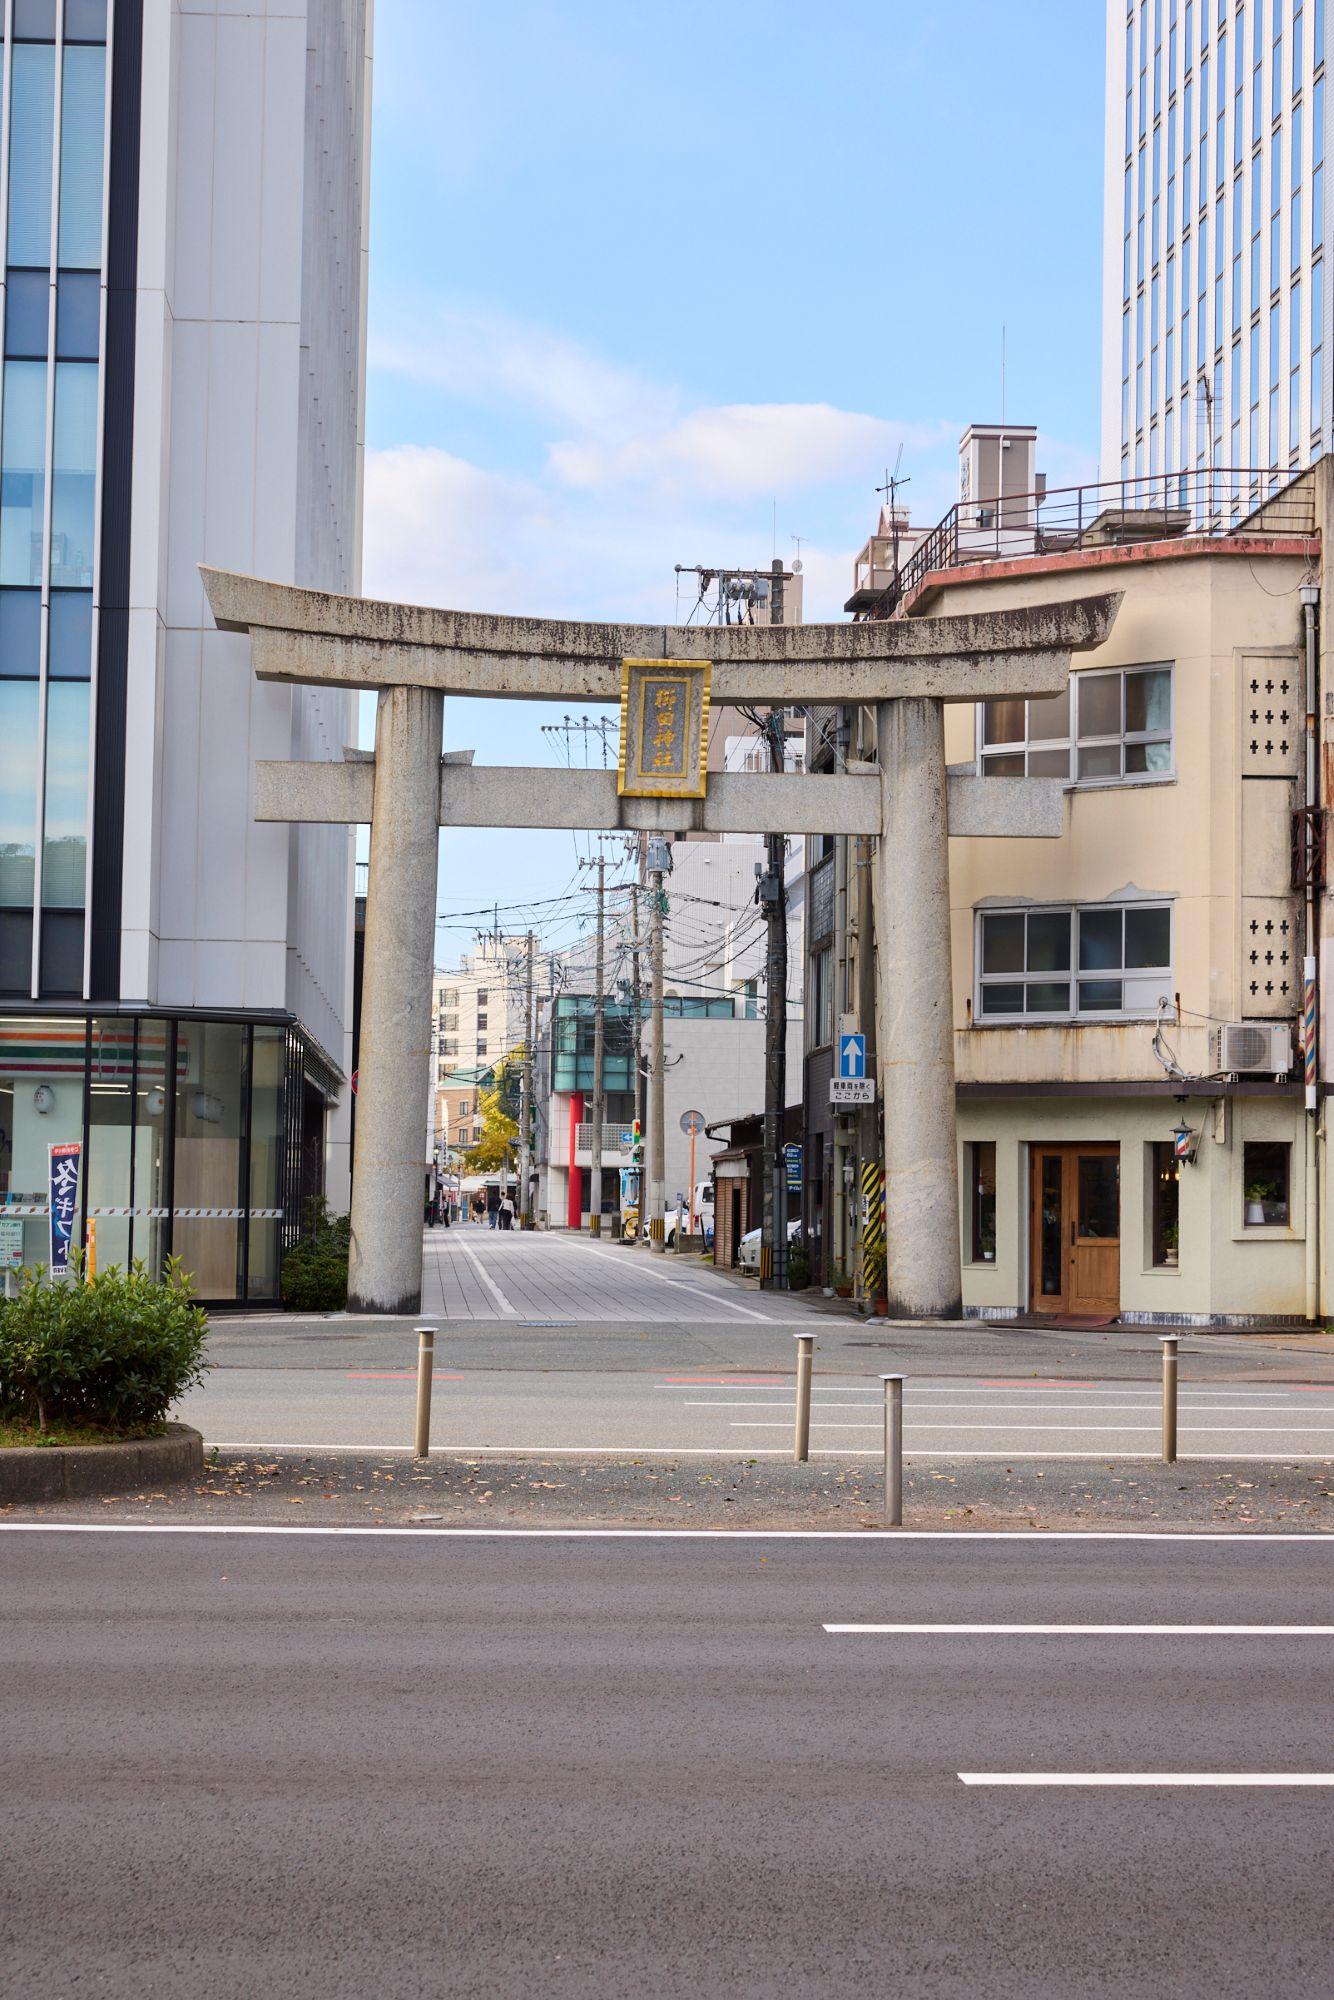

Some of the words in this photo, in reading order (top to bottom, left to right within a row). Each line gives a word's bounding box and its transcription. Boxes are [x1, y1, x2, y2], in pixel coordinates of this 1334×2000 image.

[654, 687, 677, 768] 櫛田神社
[834, 1082, 871, 1090] 軽車両を除く
